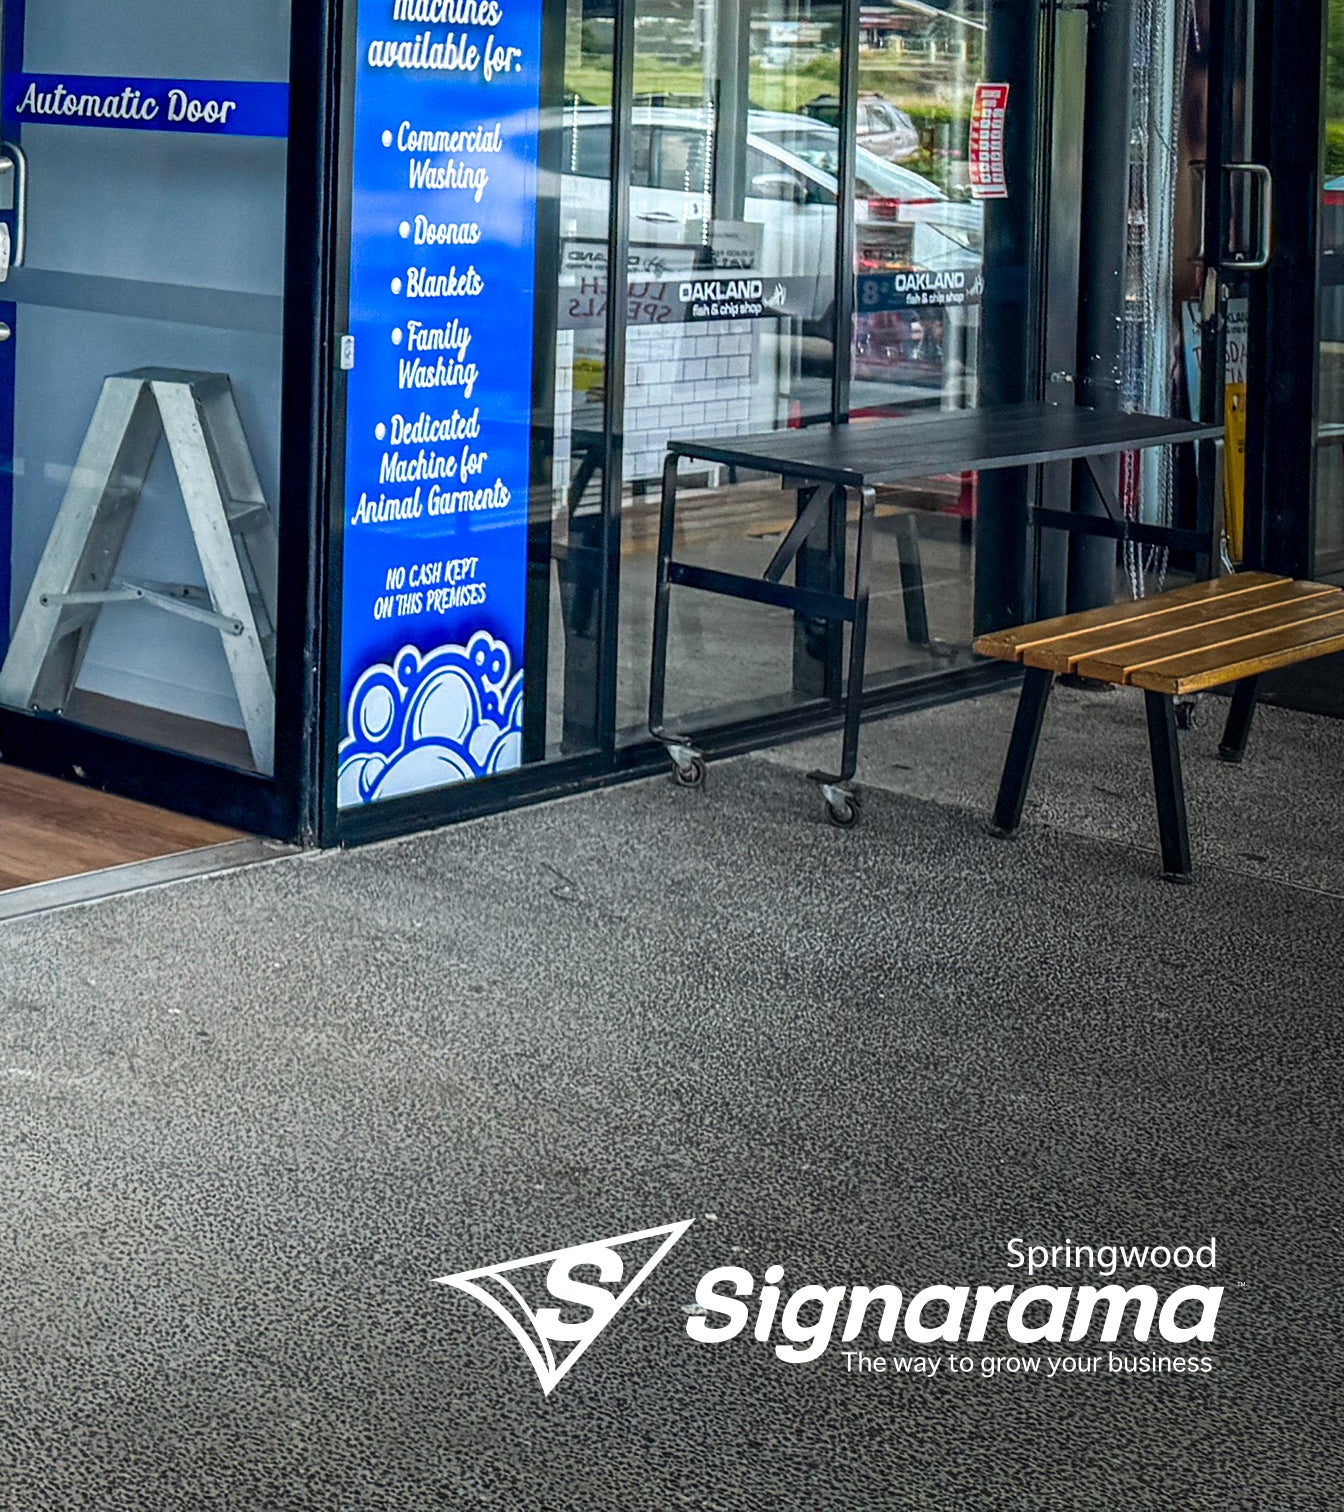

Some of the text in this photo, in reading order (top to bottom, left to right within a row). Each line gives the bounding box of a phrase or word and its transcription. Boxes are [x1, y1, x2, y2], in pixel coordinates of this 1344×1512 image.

[368, 32, 523, 82] available for:
[16, 83, 236, 124] Automatic Door
[397, 120, 503, 153] Commercial
[409, 158, 489, 203] Washing
[414, 214, 481, 245] Doonas
[406, 265, 484, 298] Blankets
[679, 280, 762, 302] OAKLAND
[895, 272, 964, 291] OAKLAND
[740, 303, 762, 316] shop
[407, 318, 472, 361] Family
[398, 356, 479, 399] Washing
[390, 407, 480, 445] Dedicated
[379, 445, 488, 484] Machine for
[351, 478, 511, 525] Animal Garments
[385, 557, 479, 590] NO CASH KEPT
[373, 583, 487, 620] ON THIS PREMISES
